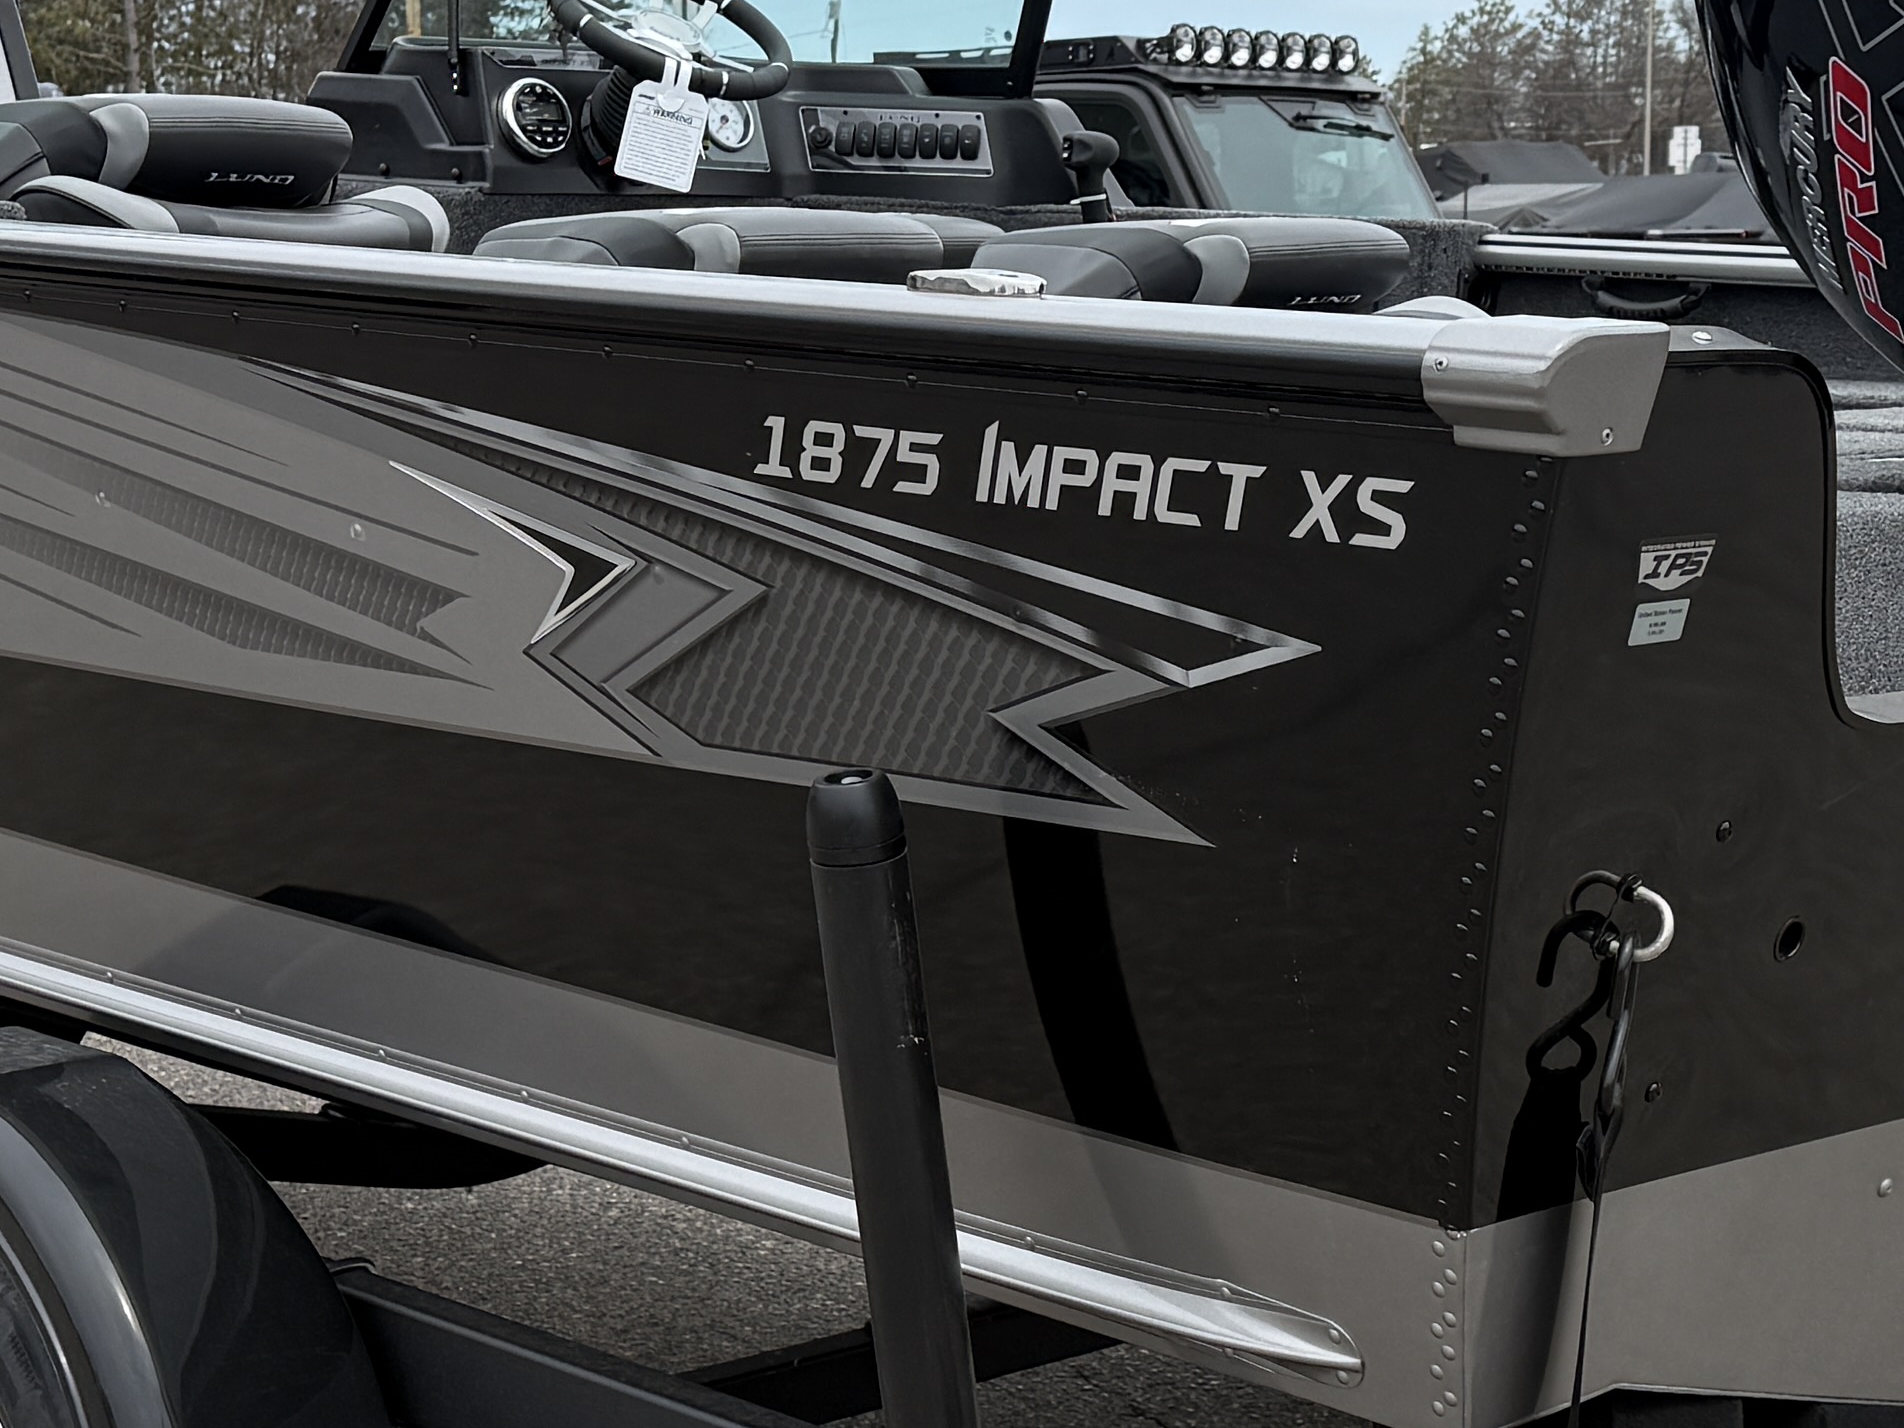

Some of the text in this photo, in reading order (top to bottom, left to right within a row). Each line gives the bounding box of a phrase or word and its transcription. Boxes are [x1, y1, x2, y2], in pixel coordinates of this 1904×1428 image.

[204, 172, 296, 185] LUND
[1786, 66, 1846, 295] MERCURY
[1287, 294, 1362, 307] LUND
[753, 414, 1415, 551] 1875 IMPACT XS
[1643, 551, 1709, 580] IPS
